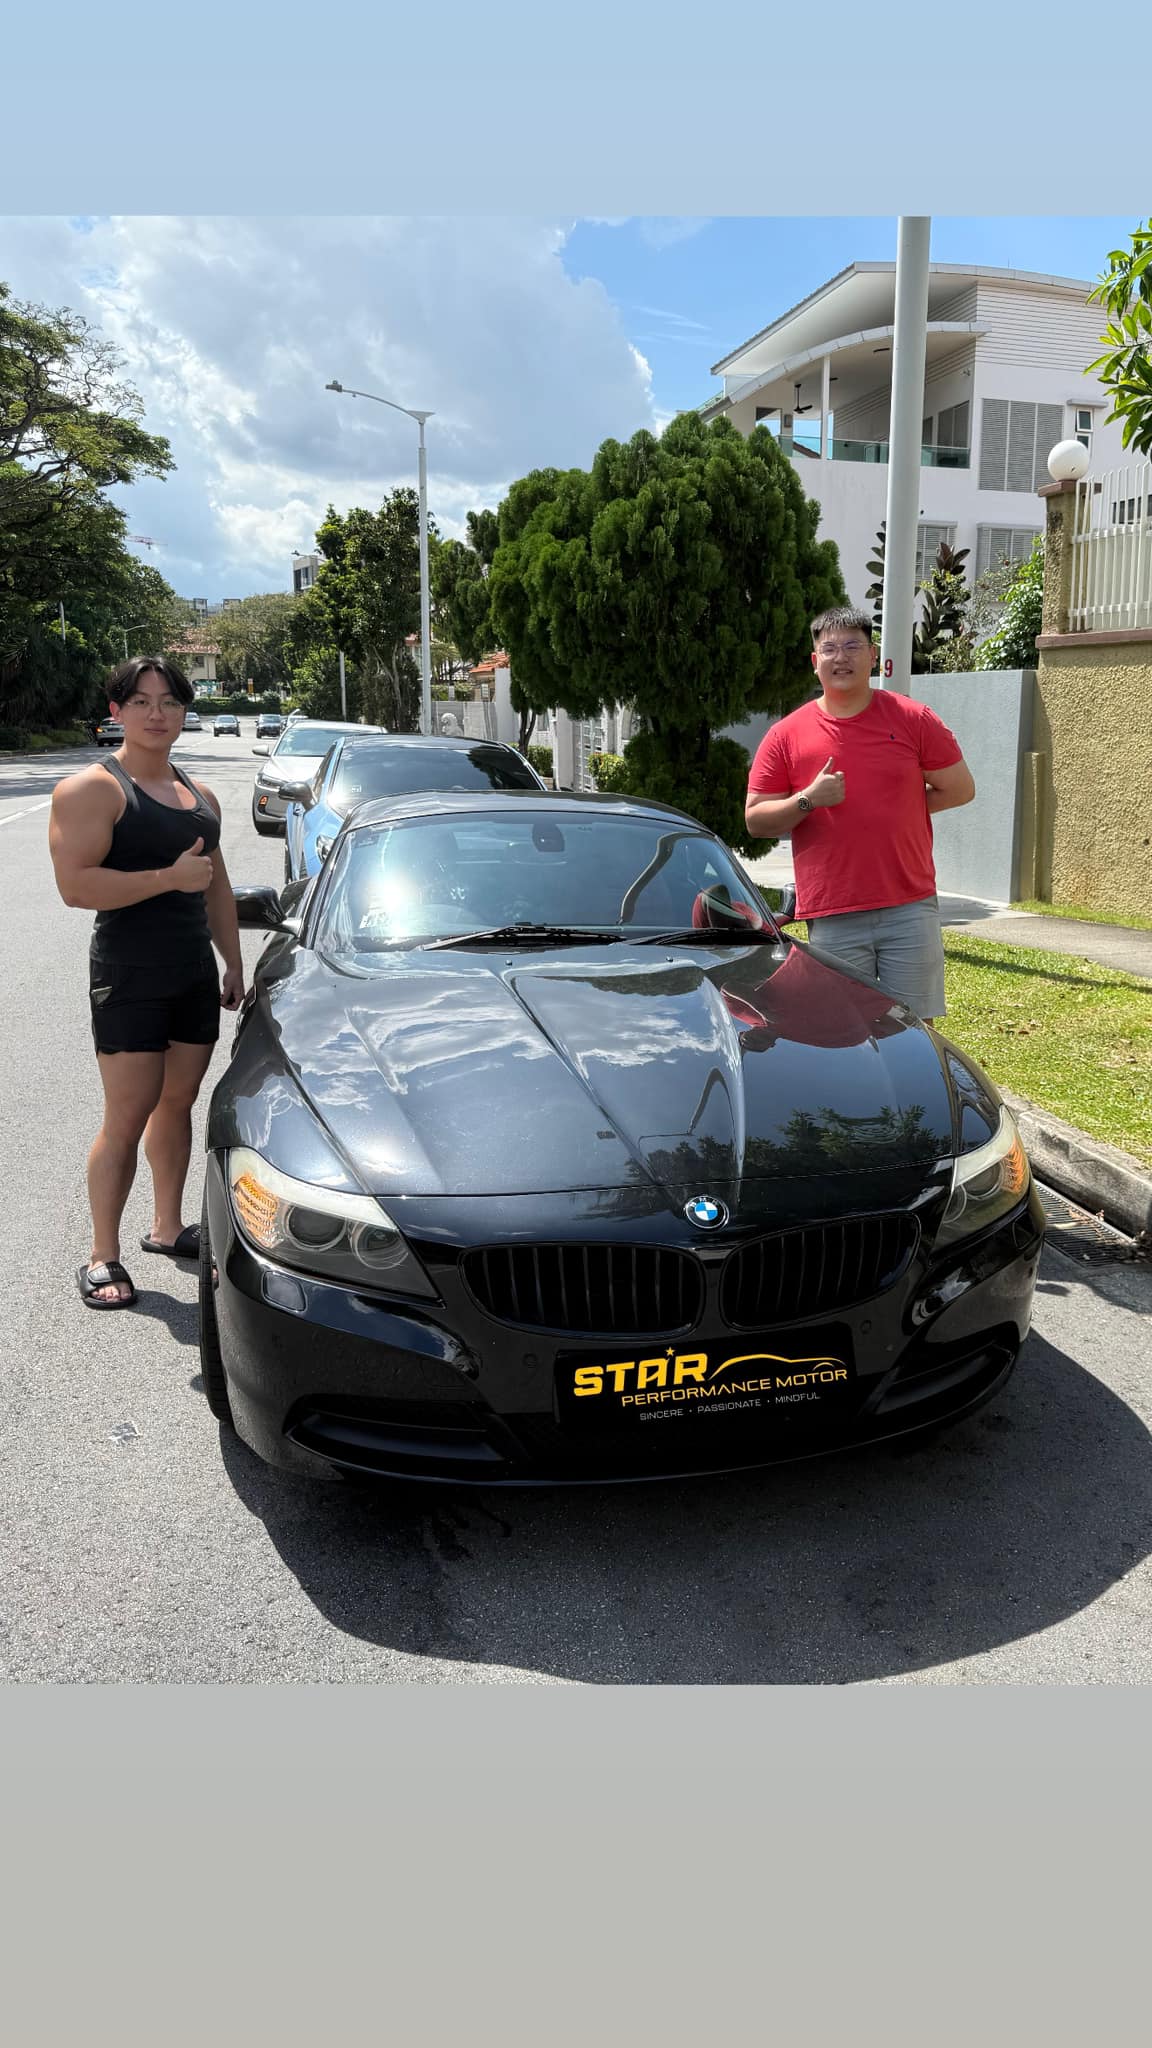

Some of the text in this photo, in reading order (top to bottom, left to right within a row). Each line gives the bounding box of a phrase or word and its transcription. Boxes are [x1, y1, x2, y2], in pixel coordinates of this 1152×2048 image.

[573, 1353, 708, 1396] STAR
[621, 1369, 847, 1407] PERFORMANCE MOTOR
[639, 1391, 820, 1421] SINCERE PASSIONATE MINDFUL
